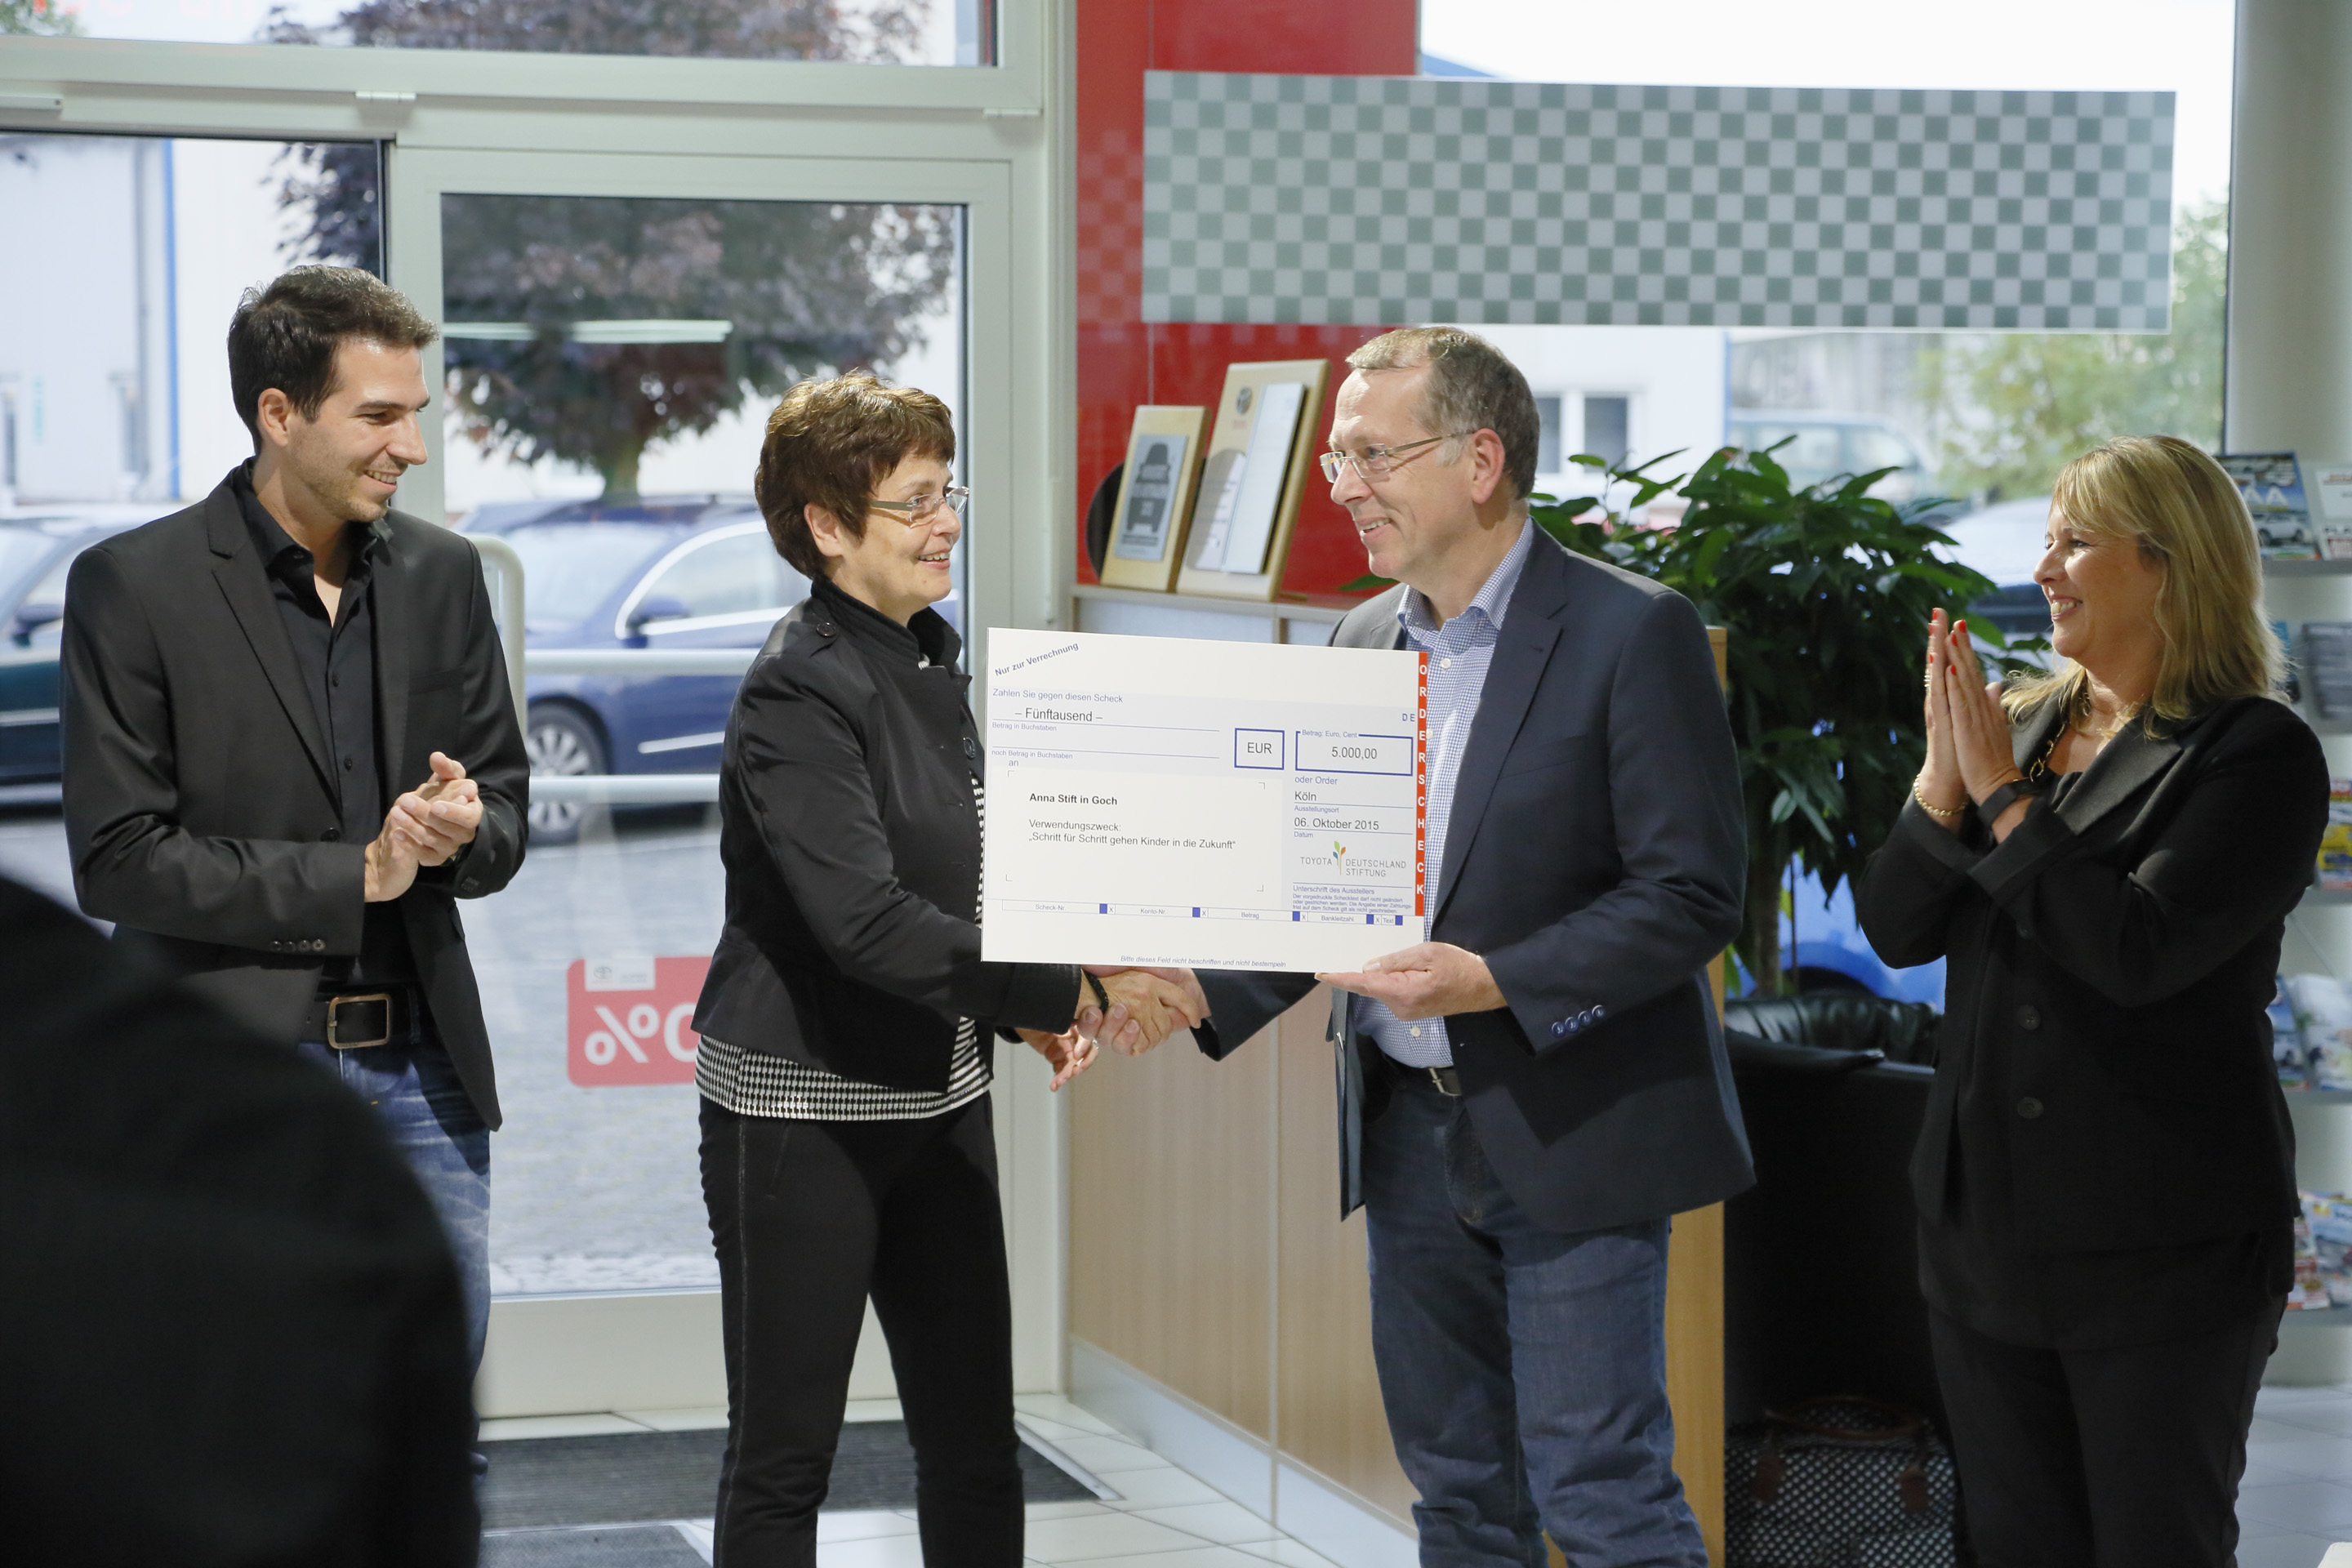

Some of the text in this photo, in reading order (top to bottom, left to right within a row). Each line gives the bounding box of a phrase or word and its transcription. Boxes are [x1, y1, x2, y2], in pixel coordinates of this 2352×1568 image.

[995, 643, 1079, 676] Nur zur Verrechnung
[992, 688, 1123, 703] Zahlen Sie gegen diesen Scheck
[1025, 707, 1093, 722] Fünftausend
[992, 722, 1013, 730] Betrag
[1021, 723, 1057, 732] Buchstaben
[1247, 742, 1272, 754] EUR
[1331, 746, 1378, 760] 5.000,00
[1008, 750, 1029, 758] Betrag
[1037, 751, 1073, 760] Buchstaben
[1294, 775, 1338, 785] oder Order
[1029, 793, 1117, 805] Anna Stift in Goch
[1294, 791, 1316, 801] Köln
[1294, 804, 1339, 813] Ausstellungsort
[1029, 819, 1121, 833] Verwendungszweck:
[1294, 817, 1379, 831] 06. Oktober 2015
[1294, 831, 1314, 839] Datum
[1063, 833, 1076, 843] für
[1078, 834, 1107, 844] Schritt
[1110, 835, 1138, 846] gehen
[1141, 836, 1169, 847] Kinder
[1172, 838, 1180, 847] in
[1183, 839, 1196, 848] die
[1300, 857, 1406, 869] TOYOTA DEUTSCHLAND
[1346, 868, 1386, 877] STIFTUNG
[1293, 885, 1328, 893] Unterschrift
[1342, 887, 1375, 895] Ausstellers
[1035, 903, 1067, 911] Scheck-Nr.
[1241, 911, 1259, 920] Betrag
[1321, 915, 1355, 923] Bankleitzahl
